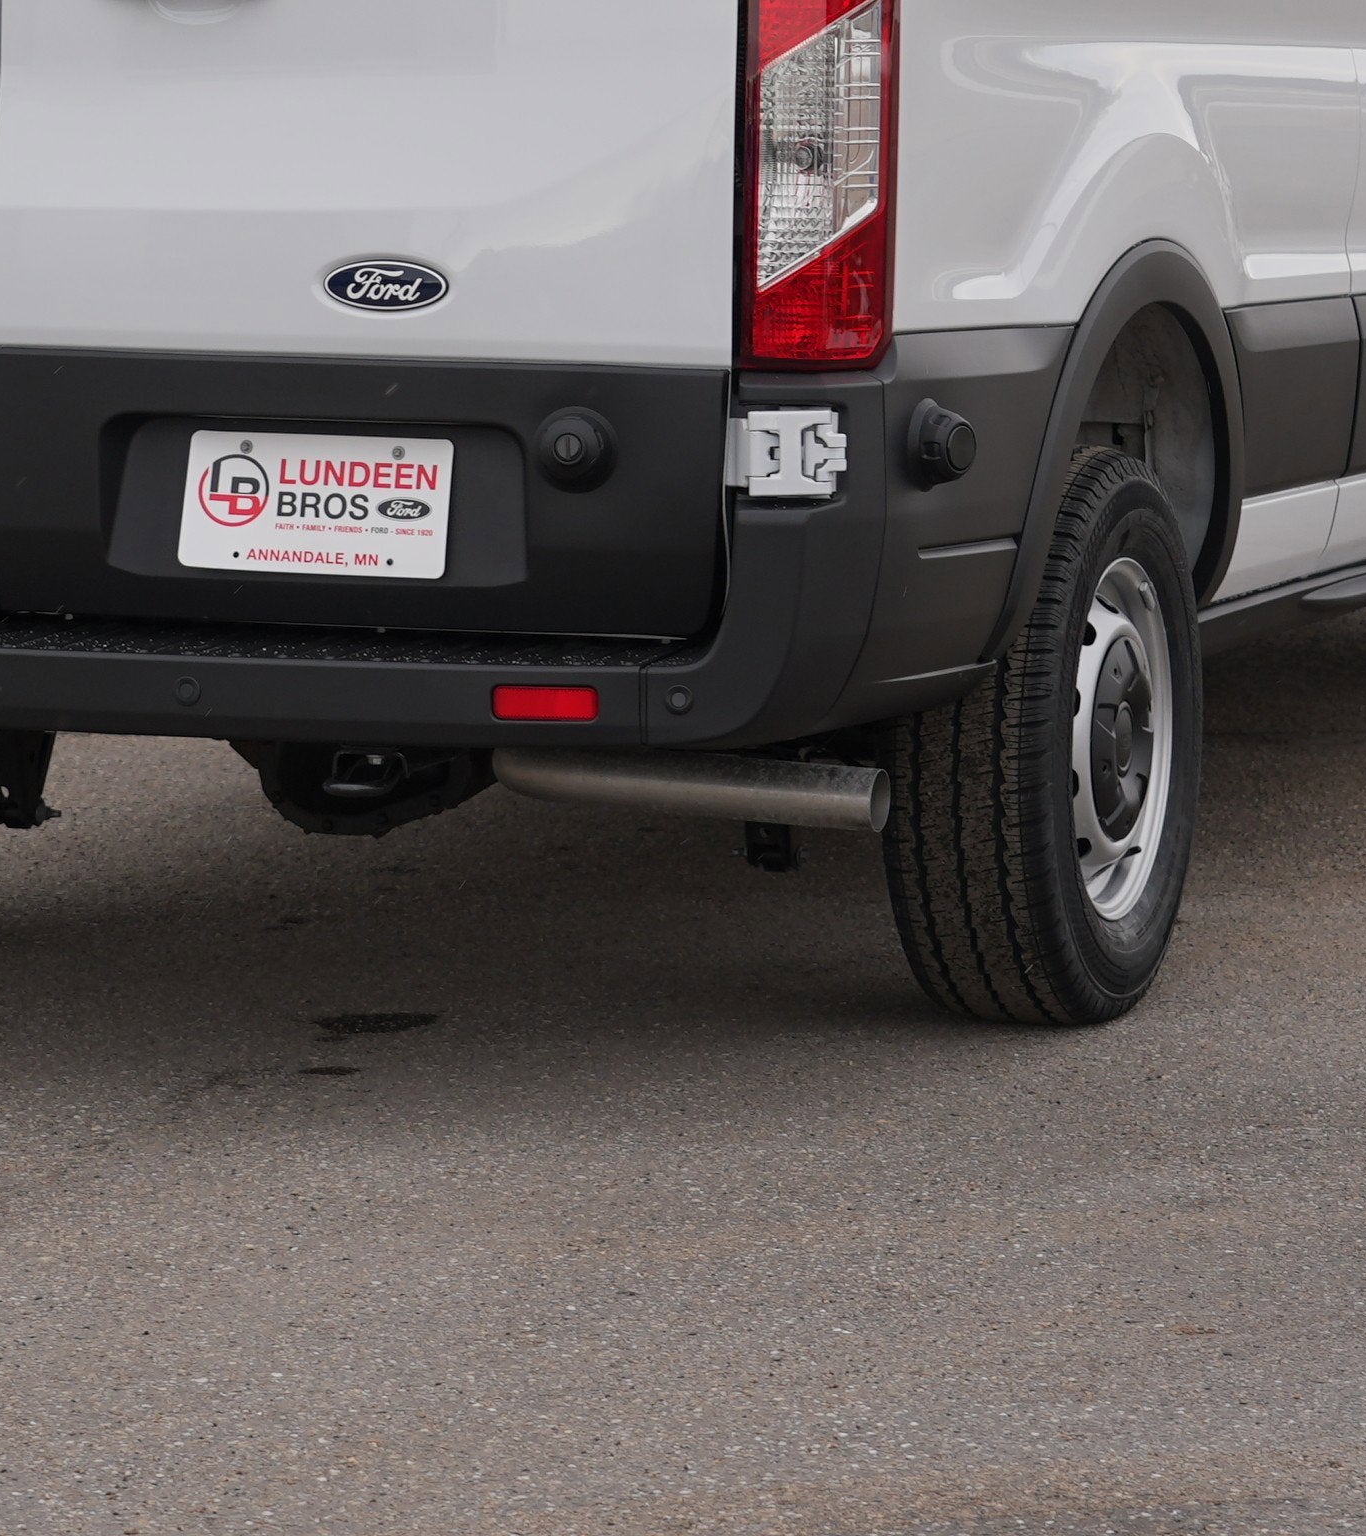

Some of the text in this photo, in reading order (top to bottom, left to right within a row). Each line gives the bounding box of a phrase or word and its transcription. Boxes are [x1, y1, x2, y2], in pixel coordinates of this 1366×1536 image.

[346, 267, 423, 302] Ford
[279, 458, 438, 491] LUNDEEN
[276, 491, 423, 521] BROS Ford
[275, 522, 295, 531] FAITH
[301, 524, 326, 532] FAMILY
[334, 525, 363, 534] FRIENDS
[370, 526, 389, 534] FORD
[395, 528, 415, 536] SINCE
[246, 548, 379, 567] ANNANDALE, MN
